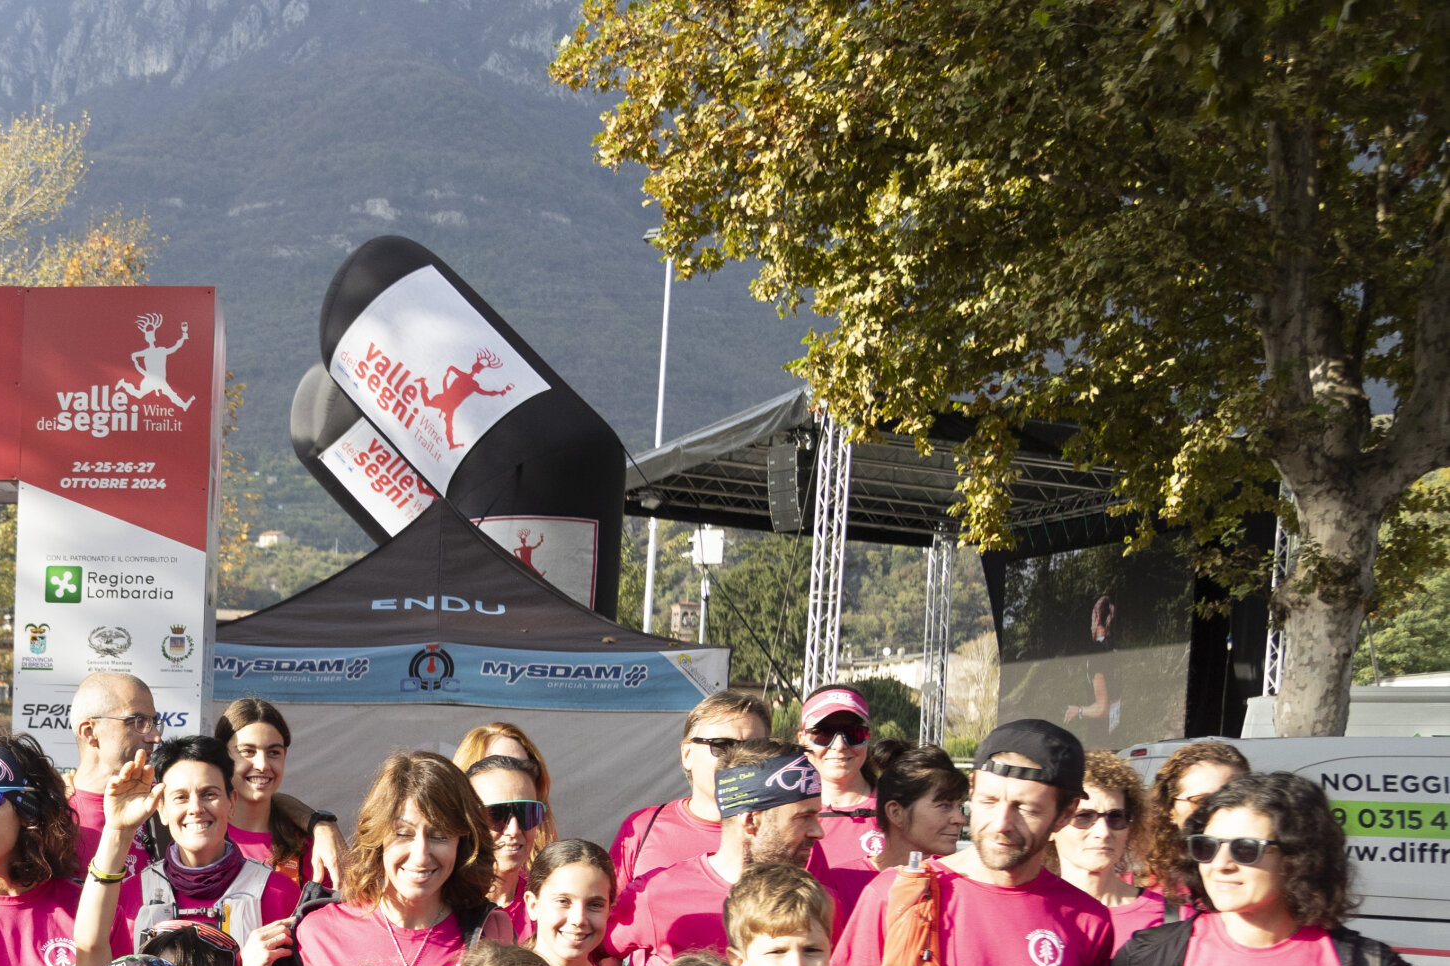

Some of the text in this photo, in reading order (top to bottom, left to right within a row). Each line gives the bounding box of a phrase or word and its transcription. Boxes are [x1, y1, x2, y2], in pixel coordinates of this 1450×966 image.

[365, 342, 418, 401] valle
[57, 385, 128, 411] valle
[143, 404, 175, 417] Wine
[142, 419, 182, 432] Trail.it
[420, 415, 443, 445] Wine
[414, 427, 442, 463] Trail.it
[72, 461, 155, 473] 24-25-26-27
[60, 477, 166, 489] OTTOBRE 2024
[87, 571, 155, 587] Regione
[87, 587, 174, 600] Lombardia
[371, 595, 506, 615] ENDU
[592, 682, 619, 690] TIMER
[1358, 808, 1423, 830] 0315
